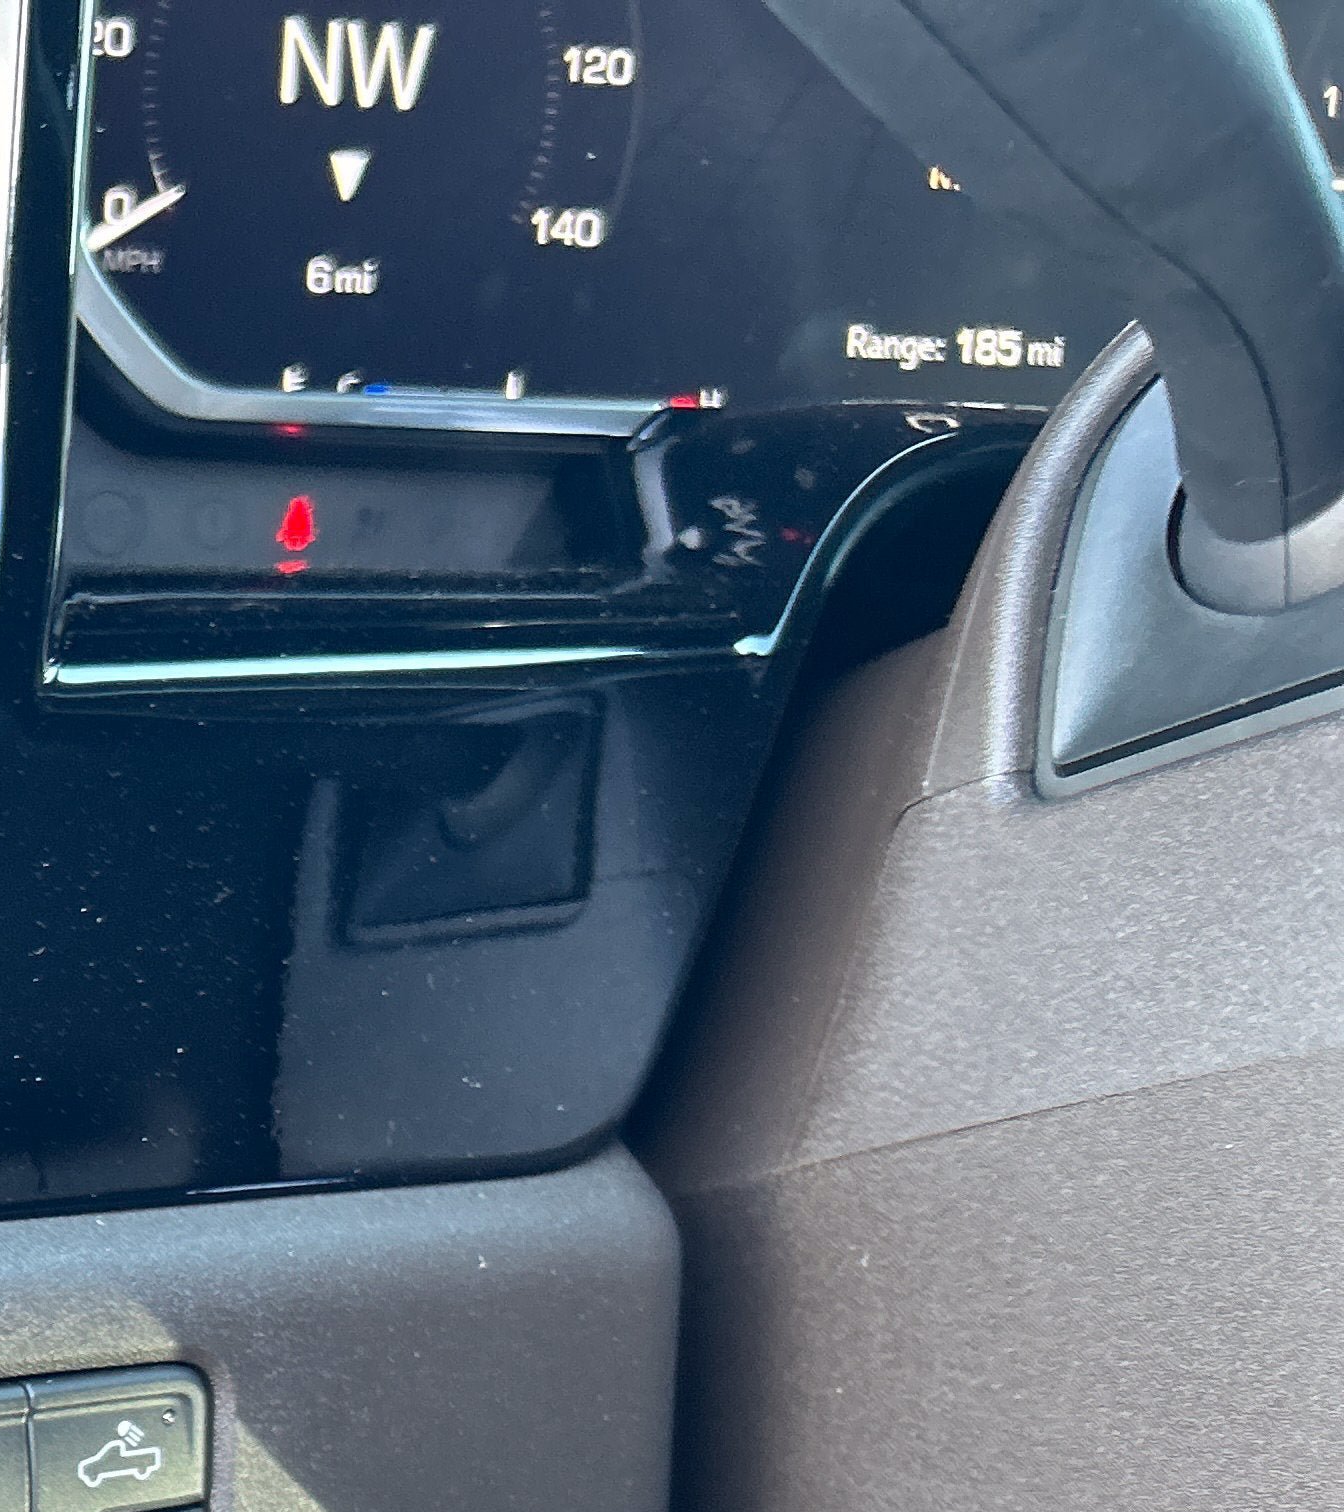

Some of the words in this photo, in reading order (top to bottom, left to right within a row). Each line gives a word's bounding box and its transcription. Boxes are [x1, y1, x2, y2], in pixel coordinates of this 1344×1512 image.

[279, 16, 436, 110] NW
[564, 46, 635, 86] 120
[530, 208, 605, 248] 140
[846, 324, 947, 371] Range:
[957, 327, 1023, 367] 185
[1027, 336, 1065, 367] mi
